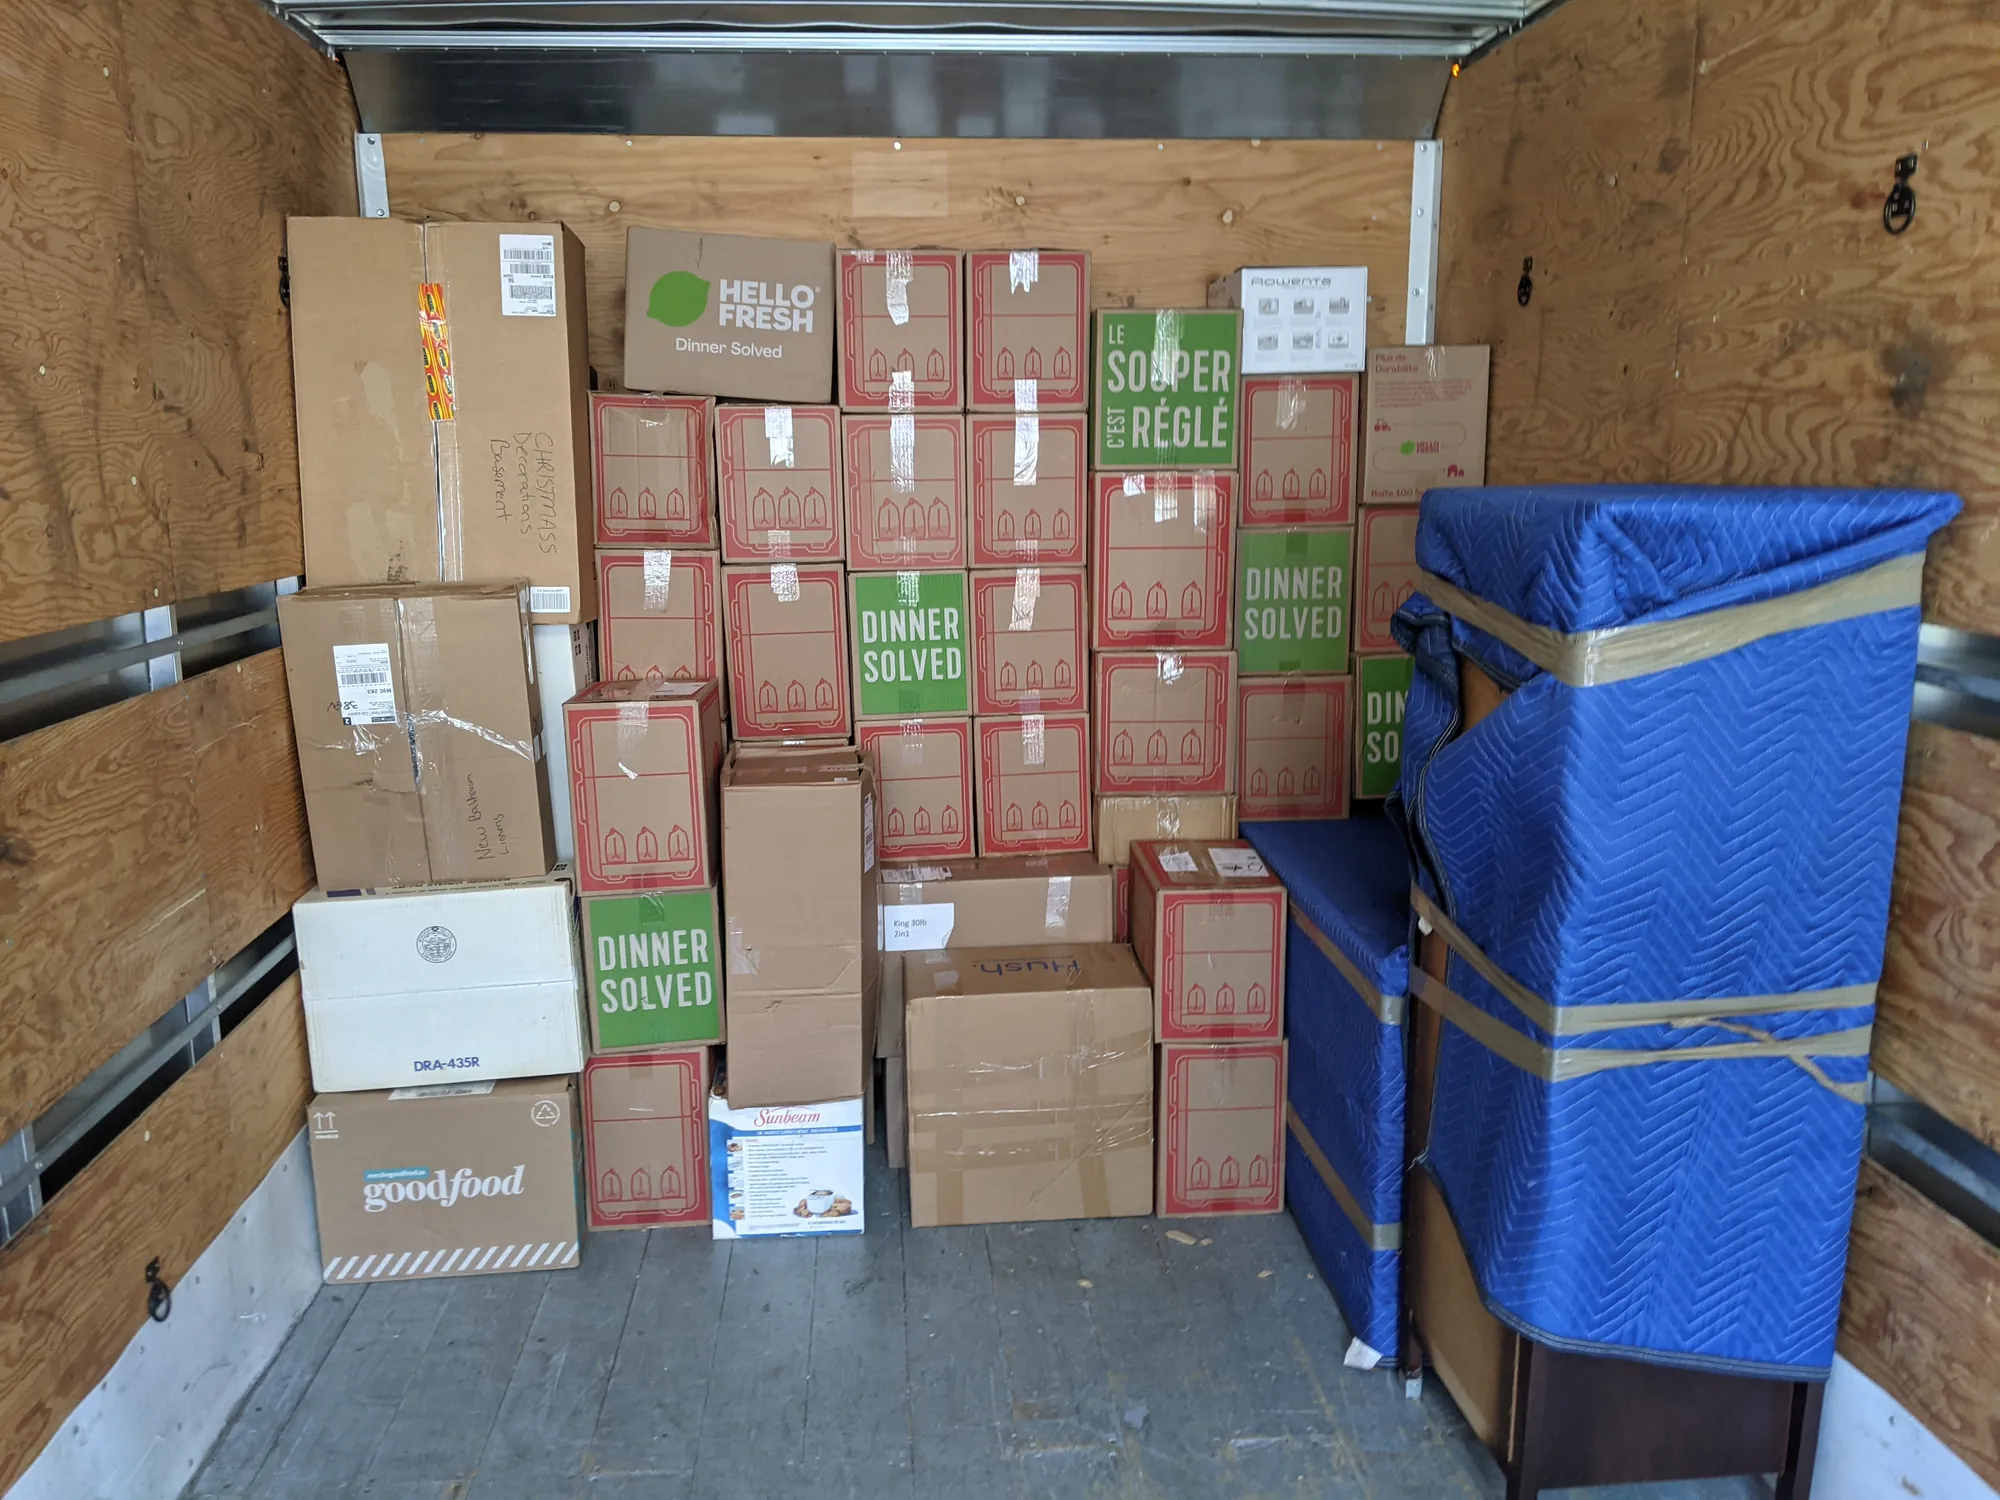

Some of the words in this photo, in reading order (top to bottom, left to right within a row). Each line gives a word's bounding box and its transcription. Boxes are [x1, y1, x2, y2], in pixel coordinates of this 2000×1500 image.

[720, 279, 815, 309] HELLO
[719, 302, 814, 333] FRESH
[1108, 324, 1125, 345] LE
[675, 337, 726, 354] Dinner
[730, 341, 783, 359] Solved
[1107, 350, 1231, 393] SOUPER
[1106, 406, 1126, 449] C'EST
[1132, 397, 1229, 449] RÉGLÉ
[490, 439, 514, 522] Basement
[1246, 565, 1343, 601] DINNER
[862, 607, 959, 644] DINNER
[1244, 605, 1342, 640] SOLVED
[863, 647, 962, 683] SOLVED
[474, 826, 496, 860] New
[893, 919, 910, 929] King
[910, 918, 927, 928] 30lb
[893, 929, 910, 938] 2in1
[597, 928, 709, 971] DINNER
[600, 971, 712, 1014] SOLVED
[413, 1056, 480, 1071] DRA-435R
[753, 1108, 821, 1128] Sunbeam
[363, 1164, 526, 1213] goodfood
